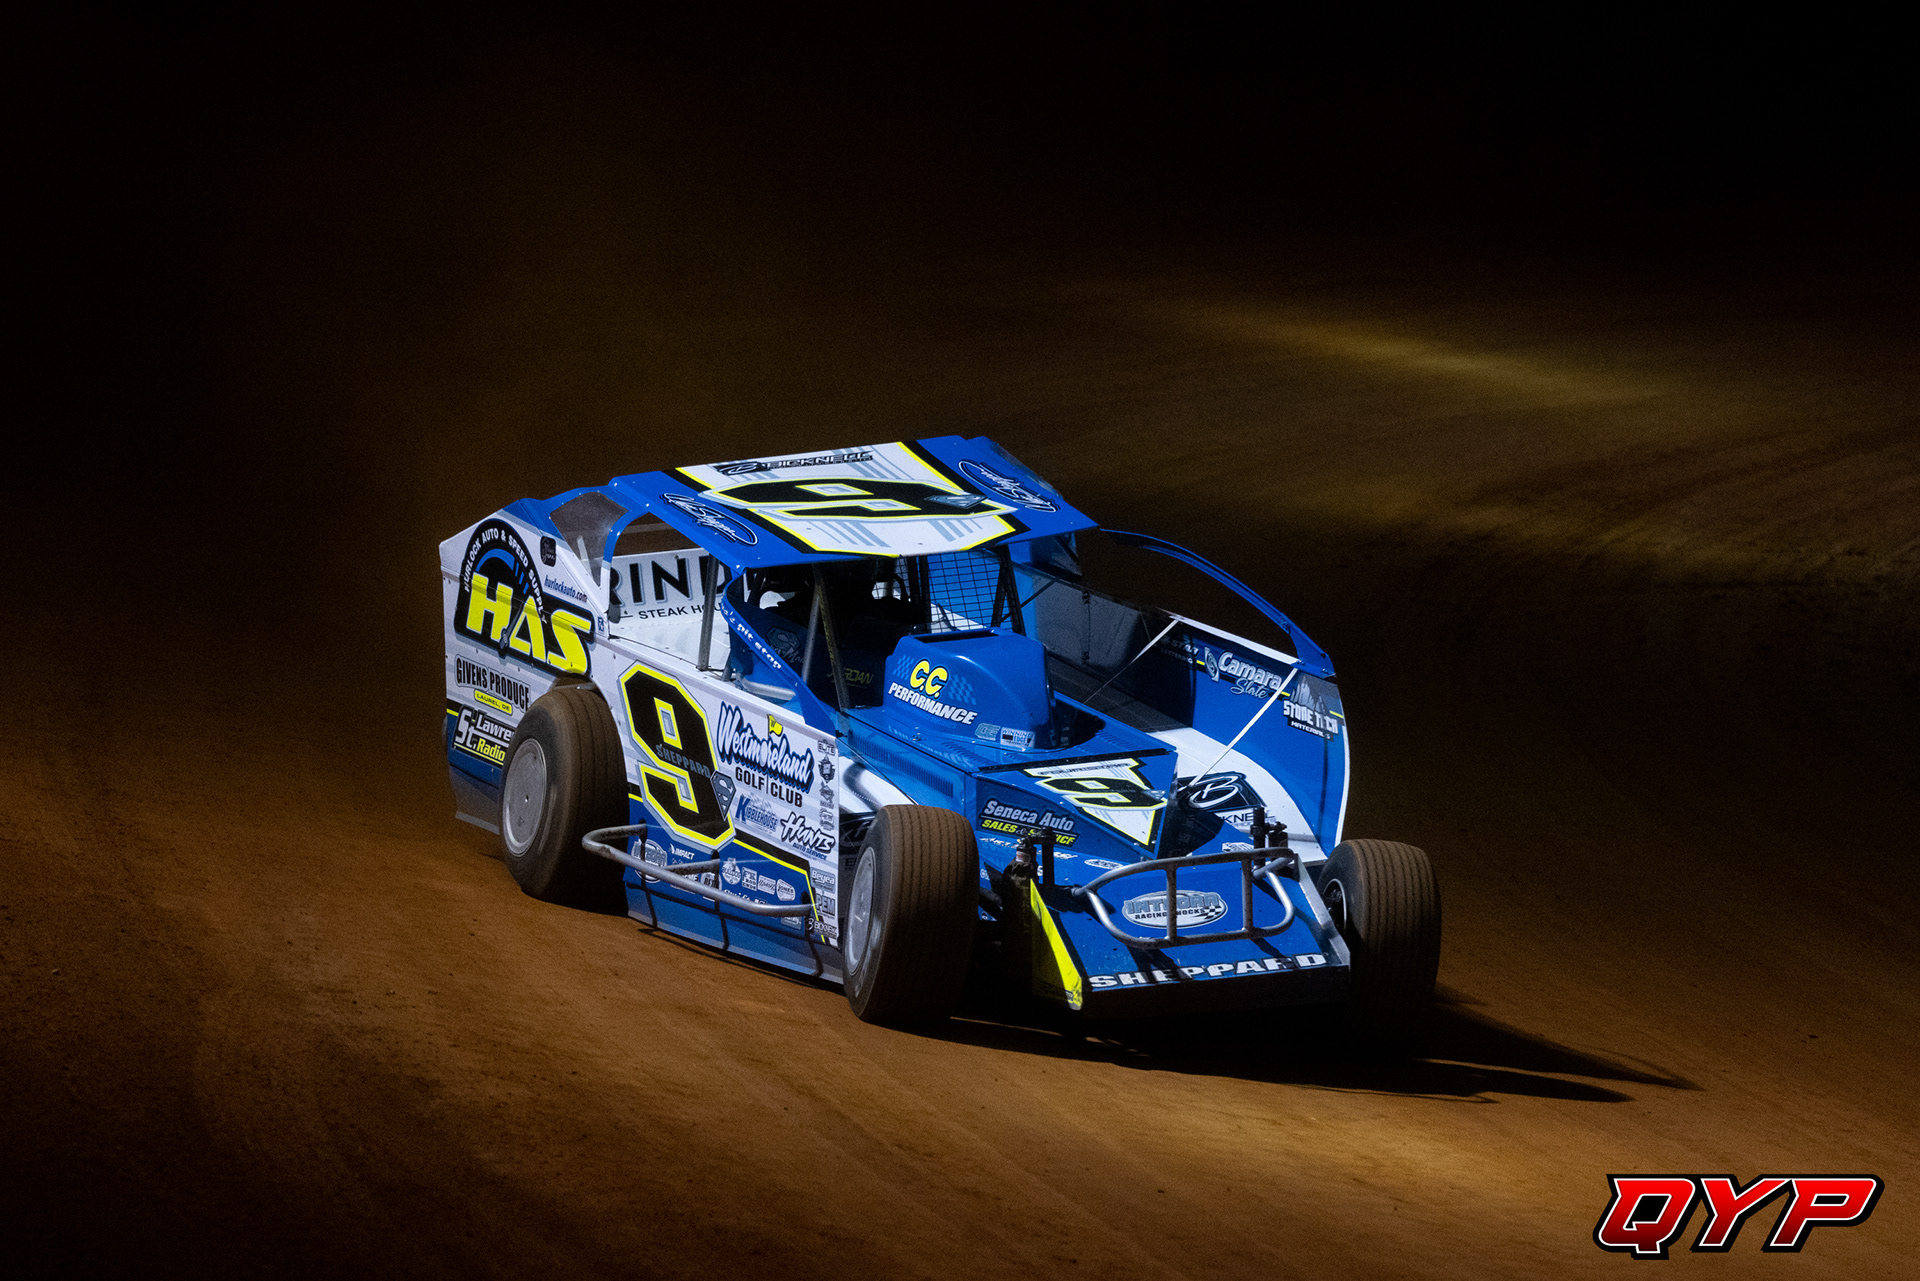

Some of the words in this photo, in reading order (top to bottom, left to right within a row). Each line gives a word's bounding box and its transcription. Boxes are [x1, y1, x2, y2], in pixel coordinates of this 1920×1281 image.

[464, 538, 481, 593] HURLOCK
[482, 527, 499, 544] AUTO
[500, 529, 507, 542] &
[508, 534, 529, 568] SPEED
[528, 568, 548, 625] SUPPLY
[543, 574, 588, 603] hurlockauto.com
[466, 571, 592, 675] HAS
[639, 605, 689, 620] STEAK
[456, 657, 488, 689] GIVENS
[489, 671, 530, 711] PRODUCE
[1217, 651, 1283, 691] Camara
[888, 682, 978, 725] PERFORMANCE
[1230, 677, 1270, 699] Slate
[1283, 699, 1314, 726] STONE
[620, 664, 735, 847] 9
[655, 743, 711, 779] SHEPPARD
[717, 701, 815, 793] Westmoreland
[735, 767, 766, 791] GOLF
[770, 782, 803, 808] CLUB
[735, 793, 779, 832] KIBBLEHOUSE
[981, 819, 1018, 833] SALES
[983, 799, 1038, 824] Seneca
[1039, 812, 1075, 832] Auto
[674, 848, 695, 861] IMPACT
[806, 848, 828, 861] SERVICE
[812, 870, 835, 886] Beyea
[815, 893, 836, 917] PEM
[1124, 891, 1221, 915] INTGRA
[1135, 911, 1169, 920] RACING
[1175, 908, 1207, 919] HOCKS
[1089, 953, 1328, 988] SHEPPARD
